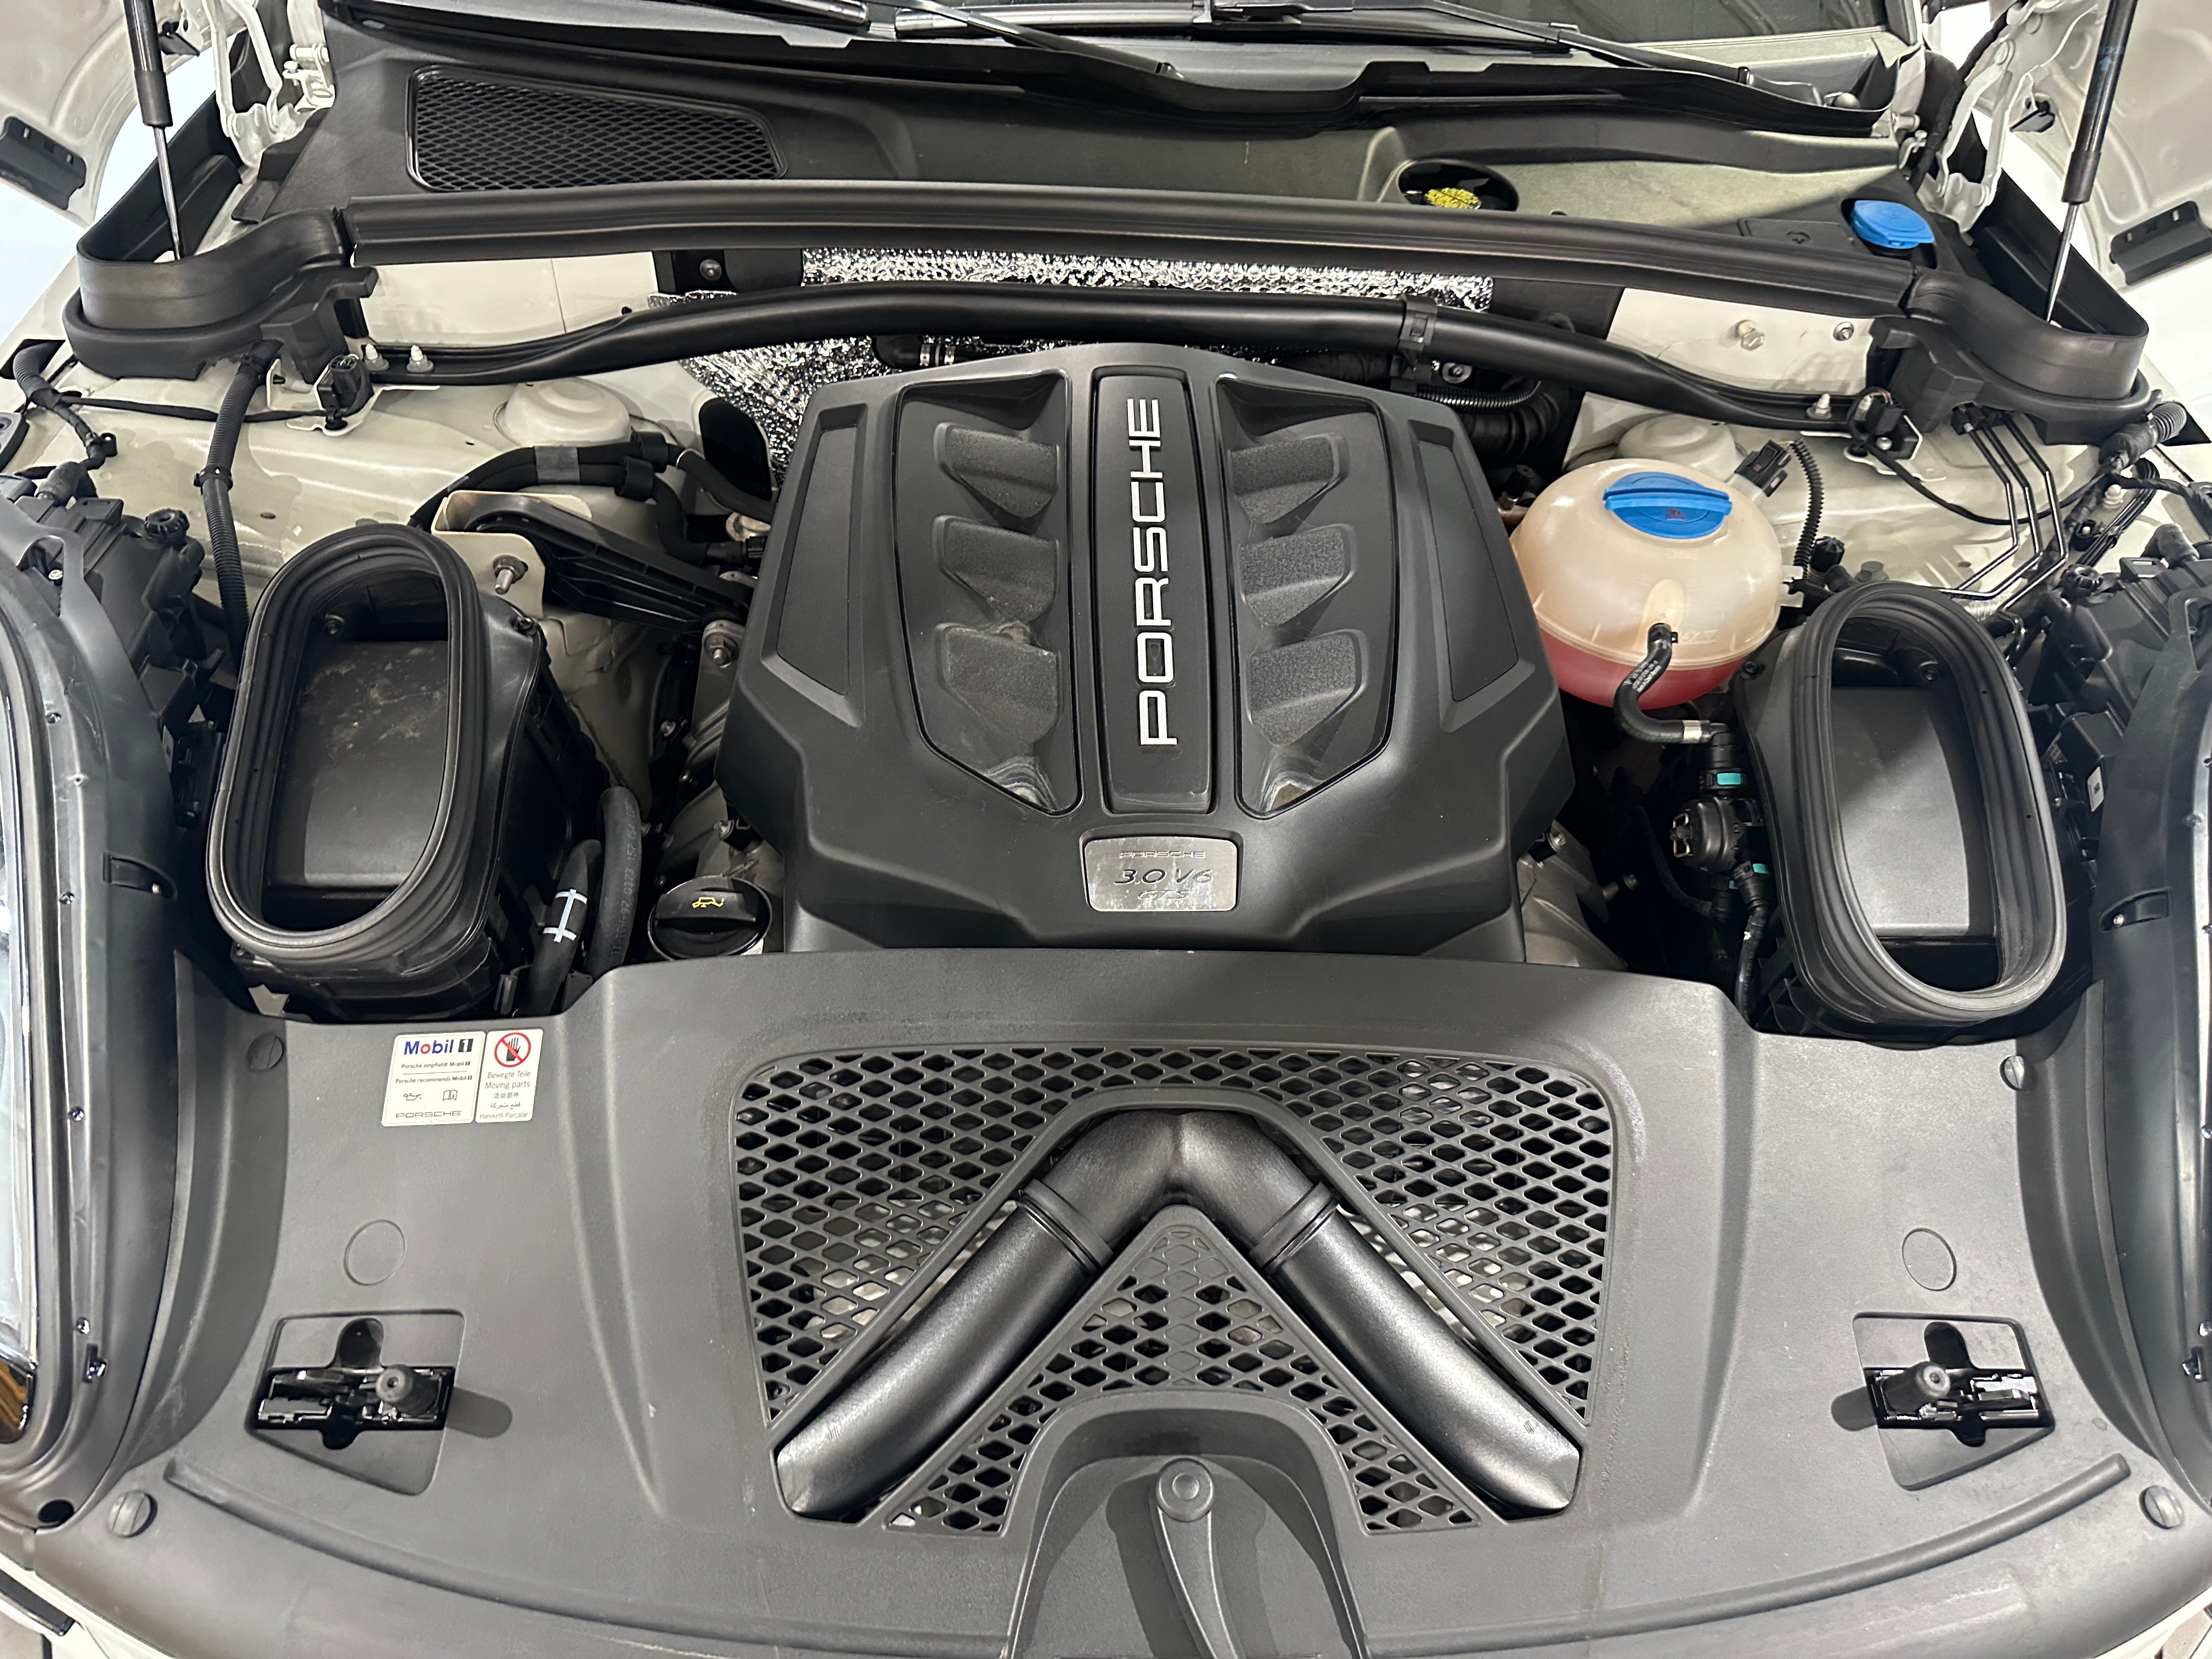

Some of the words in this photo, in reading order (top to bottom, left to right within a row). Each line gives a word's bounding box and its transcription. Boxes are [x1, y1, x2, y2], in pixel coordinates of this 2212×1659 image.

[1126, 398, 1178, 746] PORSCHE
[1119, 850, 1206, 859] PORSCHE
[1114, 868, 1167, 885] 3.0
[1176, 868, 1214, 884] V6
[1137, 890, 1190, 900] GTS
[403, 1039, 454, 1056] Mobil
[458, 1039, 473, 1053] 1
[485, 1081, 510, 1090] Moving
[511, 1081, 531, 1090] parts
[396, 1110, 462, 1119] PORSCHE
